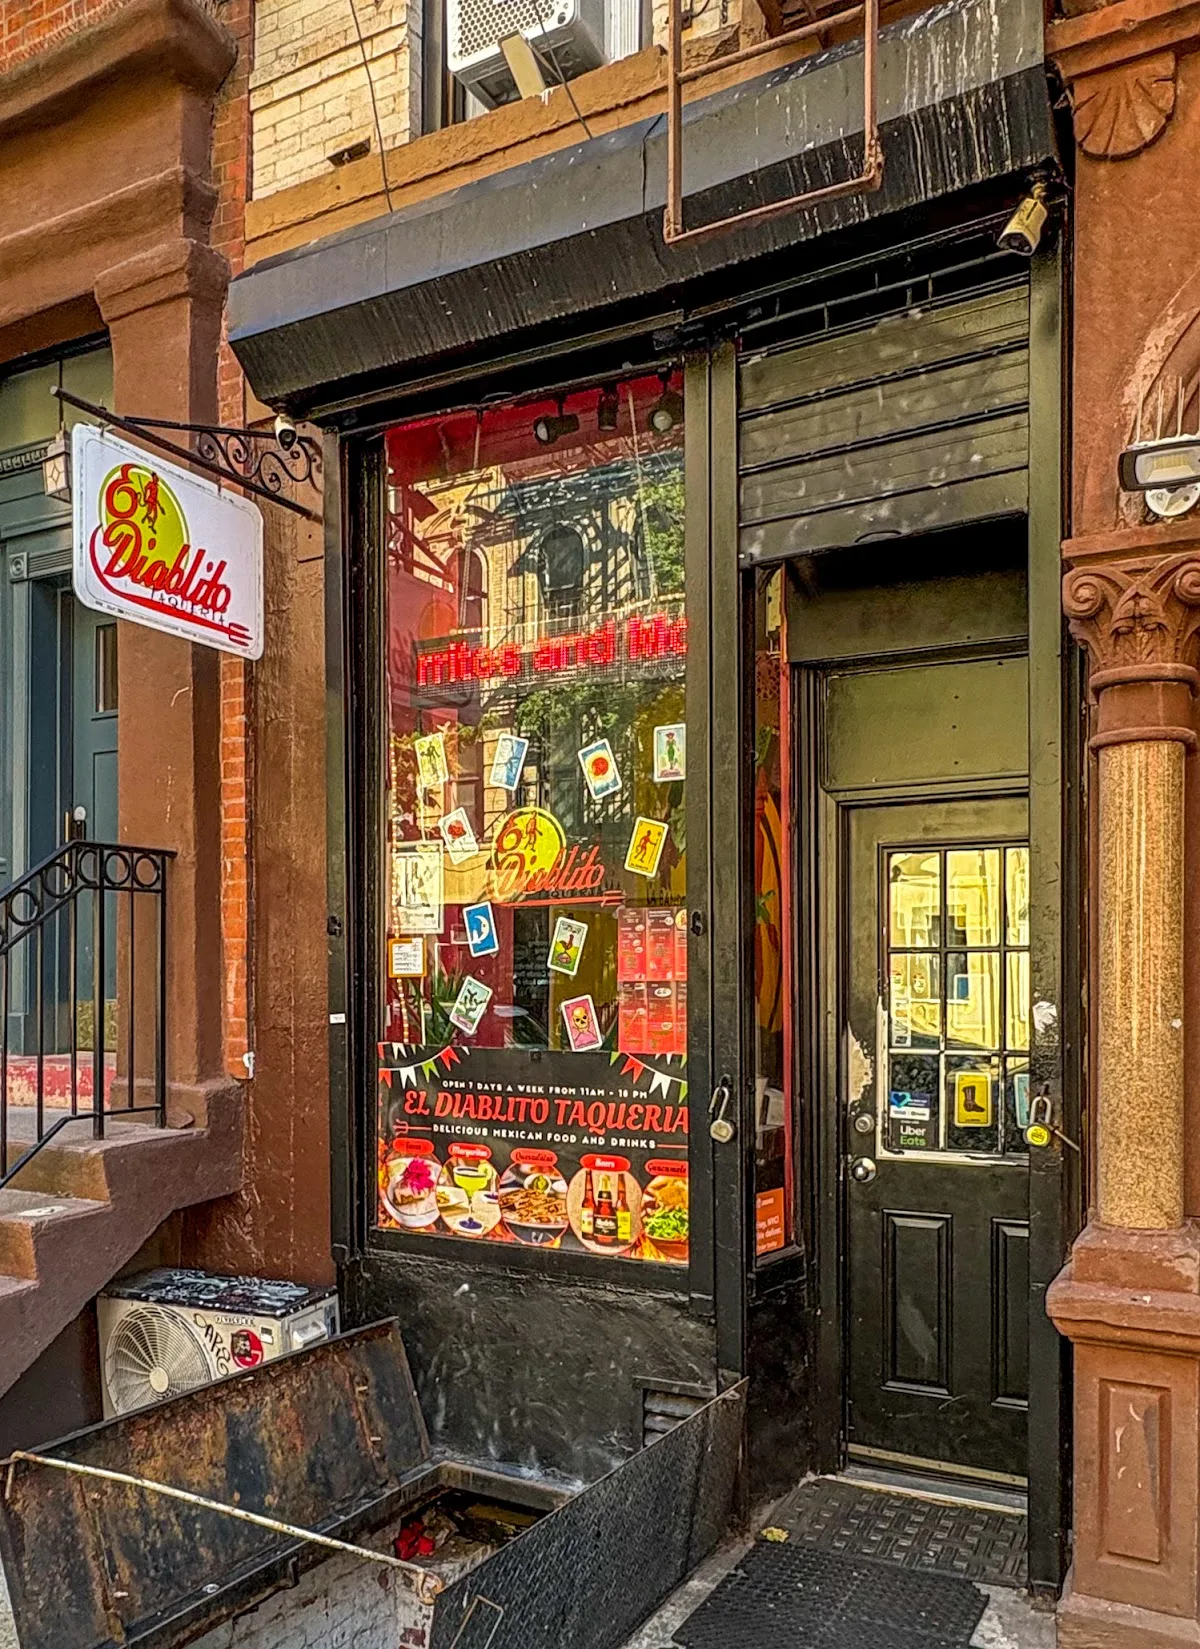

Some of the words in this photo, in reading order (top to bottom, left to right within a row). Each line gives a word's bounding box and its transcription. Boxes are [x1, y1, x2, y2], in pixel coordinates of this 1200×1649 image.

[102, 519, 231, 611] Diablito
[532, 619, 615, 672] and
[442, 1080, 465, 1089] OPEN
[468, 1081, 474, 1090] 7
[477, 1082, 502, 1091] DAYS
[506, 1084, 513, 1092] A
[518, 1085, 544, 1094] WEEK
[549, 1086, 576, 1095] FROM
[580, 1087, 605, 1097] 11AM
[632, 1090, 648, 1099] PM
[404, 1090, 430, 1116] EL
[434, 1091, 549, 1124] DIABLITO
[554, 1099, 689, 1135] TAQUERIA
[433, 1123, 488, 1137] DELICIOUS
[493, 1128, 543, 1141] MEXICAN
[547, 1132, 577, 1143] FOOD
[582, 1135, 605, 1145] AND
[611, 1137, 656, 1149] DRINKS
[899, 1125, 927, 1137] Uber
[899, 1136, 927, 1147] Eats
